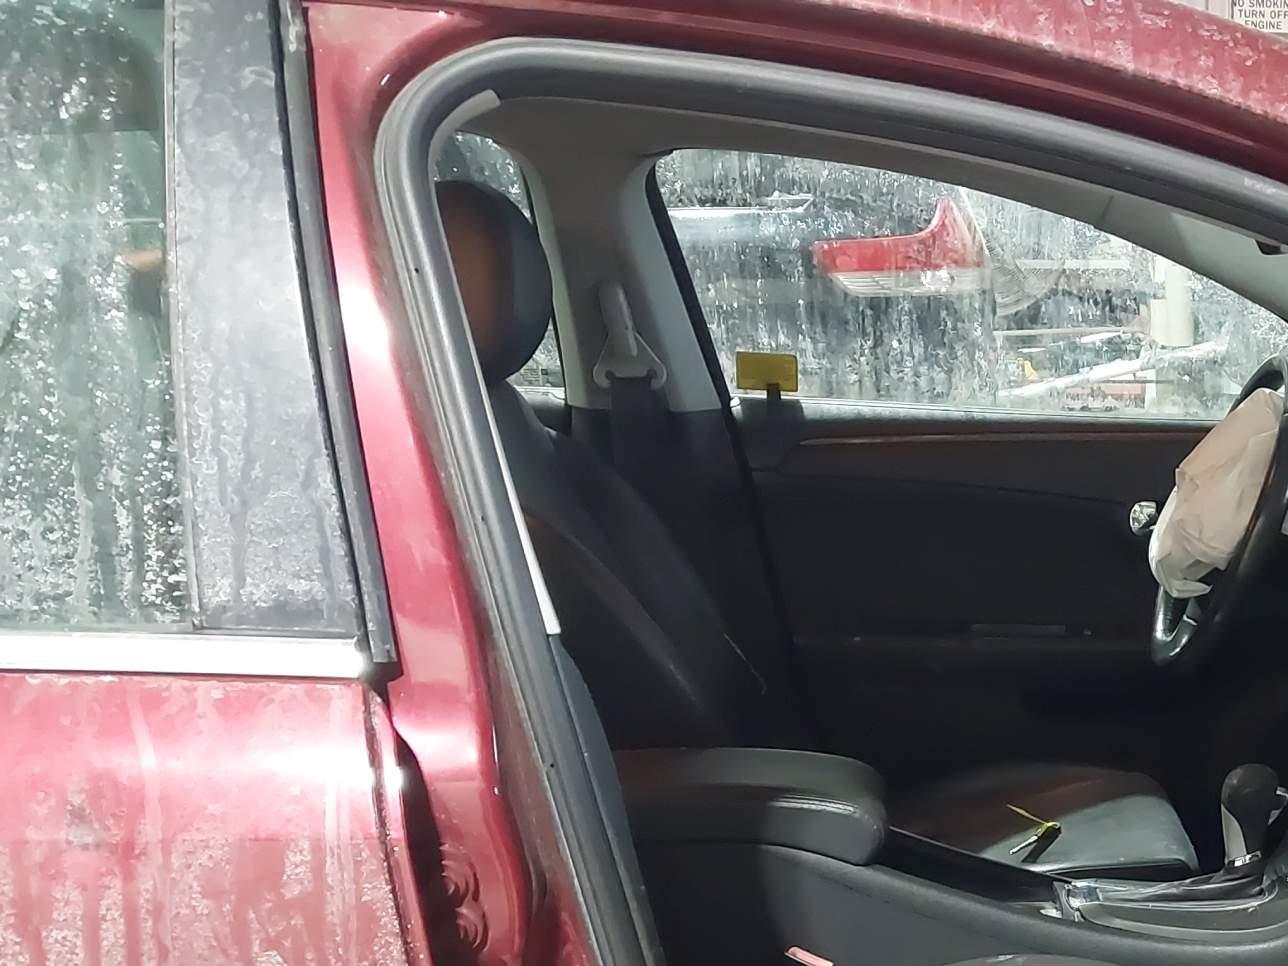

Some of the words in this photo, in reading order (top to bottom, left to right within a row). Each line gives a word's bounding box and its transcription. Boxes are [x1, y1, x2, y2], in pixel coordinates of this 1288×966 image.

[1231, 0, 1245, 8] NO
[1238, 9, 1265, 19] TURN
[1244, 20, 1283, 30] ENGINE
